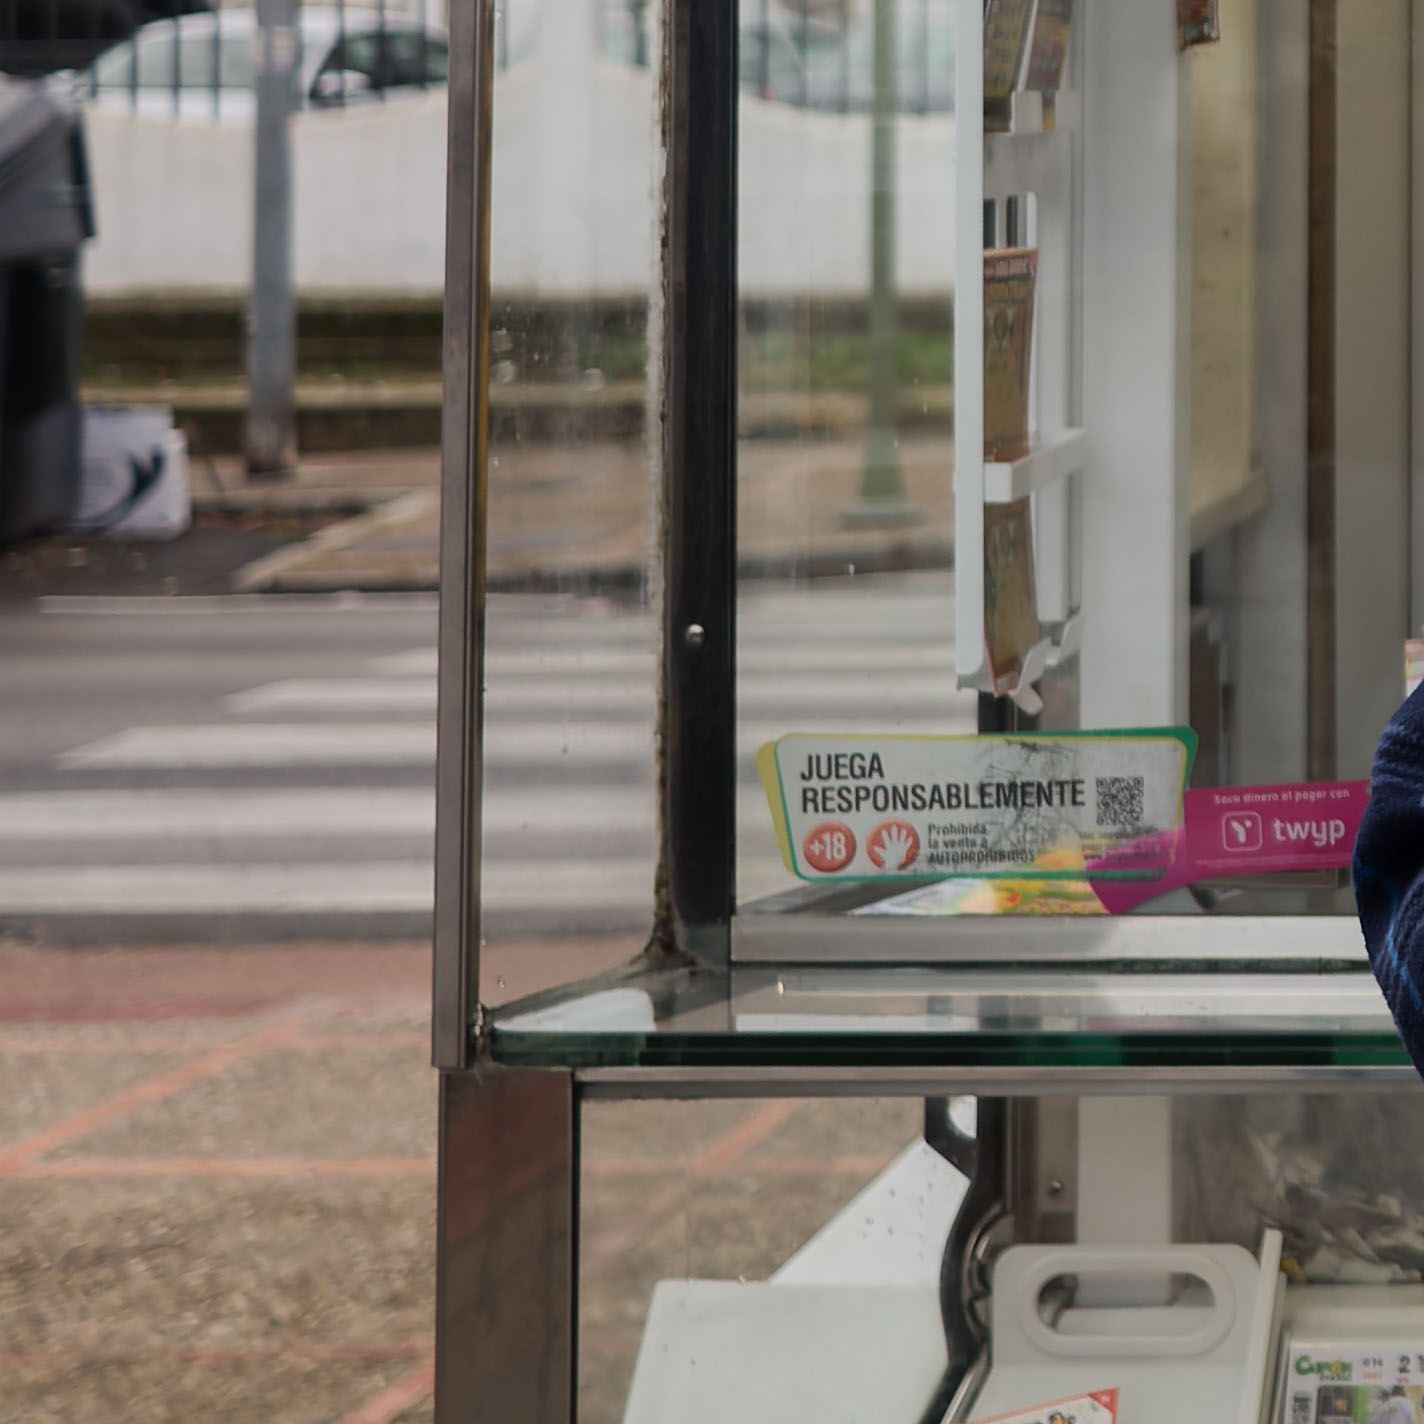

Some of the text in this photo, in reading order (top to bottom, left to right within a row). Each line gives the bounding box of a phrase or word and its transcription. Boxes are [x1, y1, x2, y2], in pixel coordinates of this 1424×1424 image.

[800, 752, 885, 781] JUEGA
[801, 778, 1086, 814] RESPONSABLEMENTE
[927, 822, 988, 836] Prohibida
[927, 836, 939, 849] la
[943, 836, 977, 849] venta
[1272, 817, 1346, 847] twyp
[810, 831, 847, 860] +18
